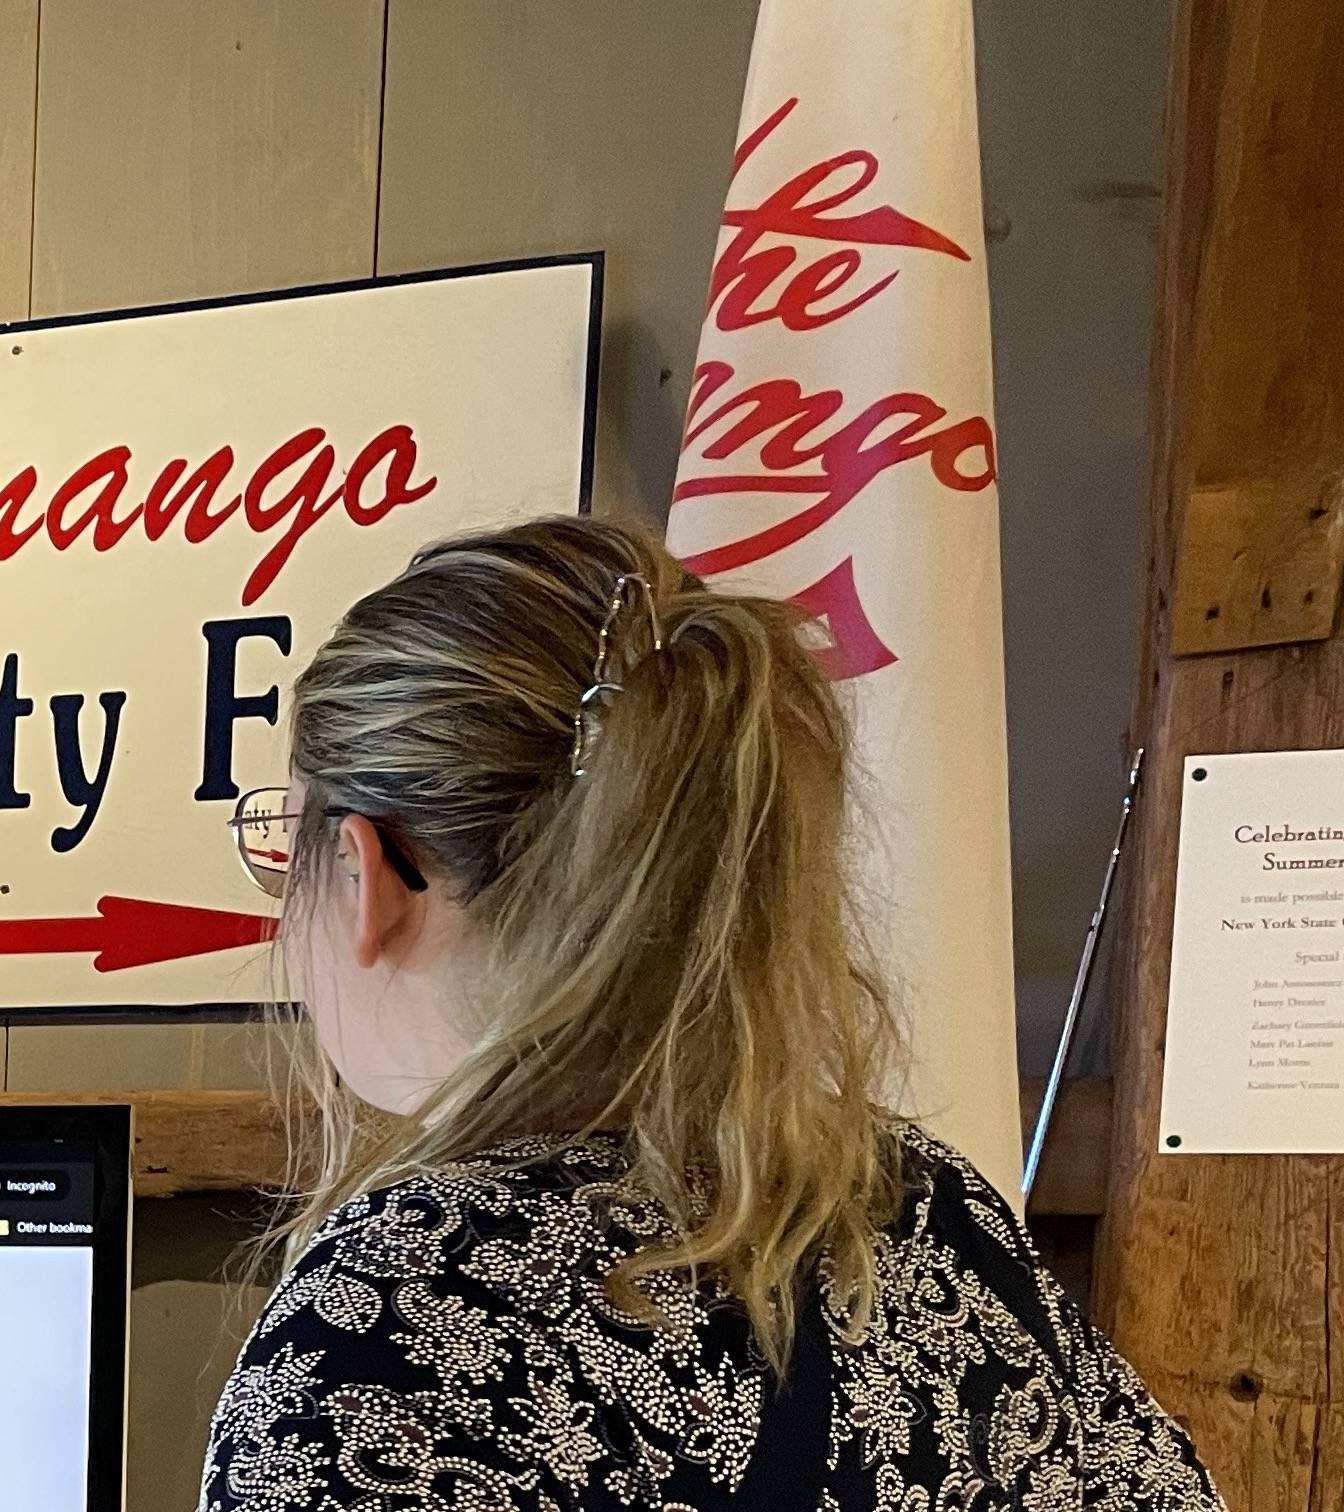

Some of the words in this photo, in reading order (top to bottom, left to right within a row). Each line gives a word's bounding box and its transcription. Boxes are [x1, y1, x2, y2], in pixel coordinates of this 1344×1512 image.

[193, 615, 292, 801] F
[1234, 825, 1344, 844] Celebratin
[1262, 852, 1344, 871] Summer
[1221, 919, 1255, 931] New
[1261, 917, 1295, 930] York
[1300, 916, 1336, 928] State
[7, 1180, 56, 1195] Incognito
[16, 1221, 47, 1234] Other
[49, 1221, 93, 1234] bookma
